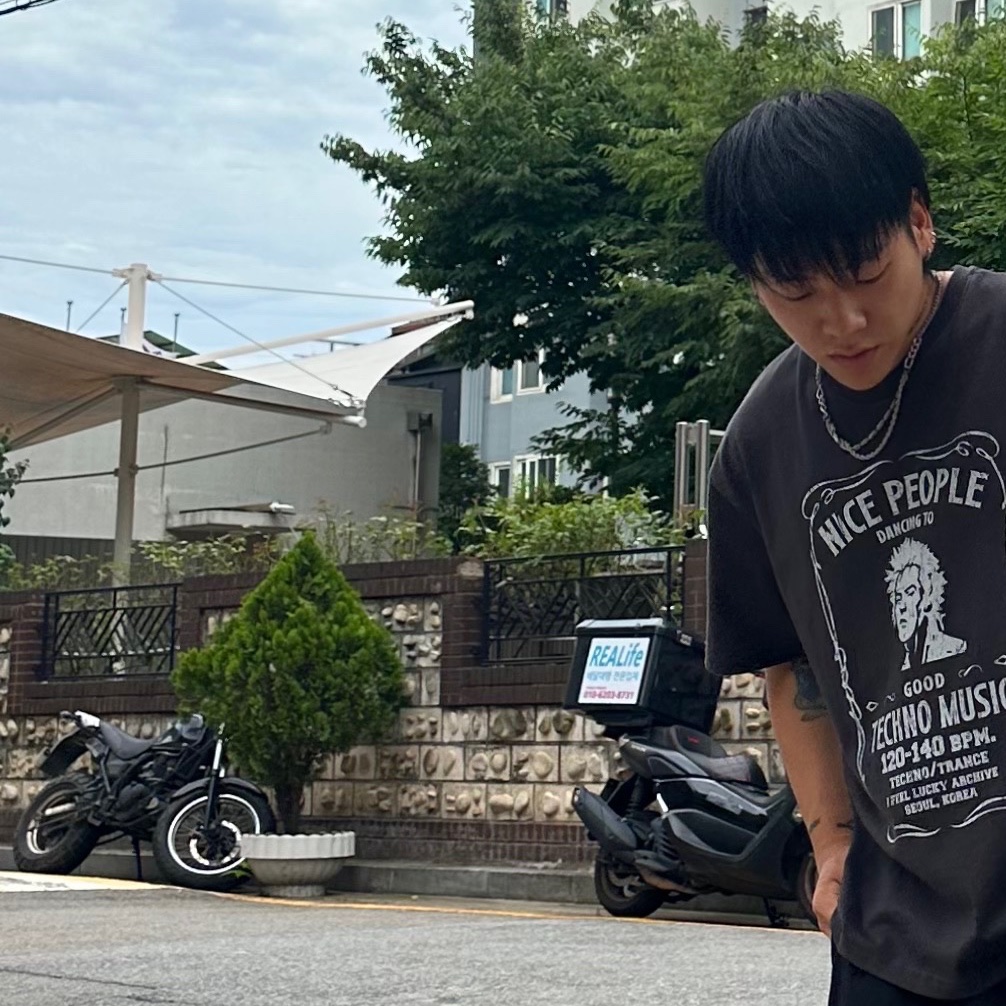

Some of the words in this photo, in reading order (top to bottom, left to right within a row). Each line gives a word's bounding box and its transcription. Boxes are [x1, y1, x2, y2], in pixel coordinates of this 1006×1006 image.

[817, 489, 883, 557] NICE
[882, 467, 989, 517] PEOPLE
[876, 513, 922, 544] DANCING
[922, 511, 934, 526] TO
[589, 642, 644, 667] REALife
[903, 672, 945, 697] GOOD
[871, 700, 932, 753] TECHNO
[881, 734, 945, 774] 120-140
[951, 726, 996, 752] BPM.
[889, 750, 990, 790] TECHNO/TRANCE
[890, 789, 911, 806] FEEL
[912, 780, 948, 799] LUCKY
[952, 766, 999, 789] ARCHIVE
[941, 787, 979, 806] KOREA
